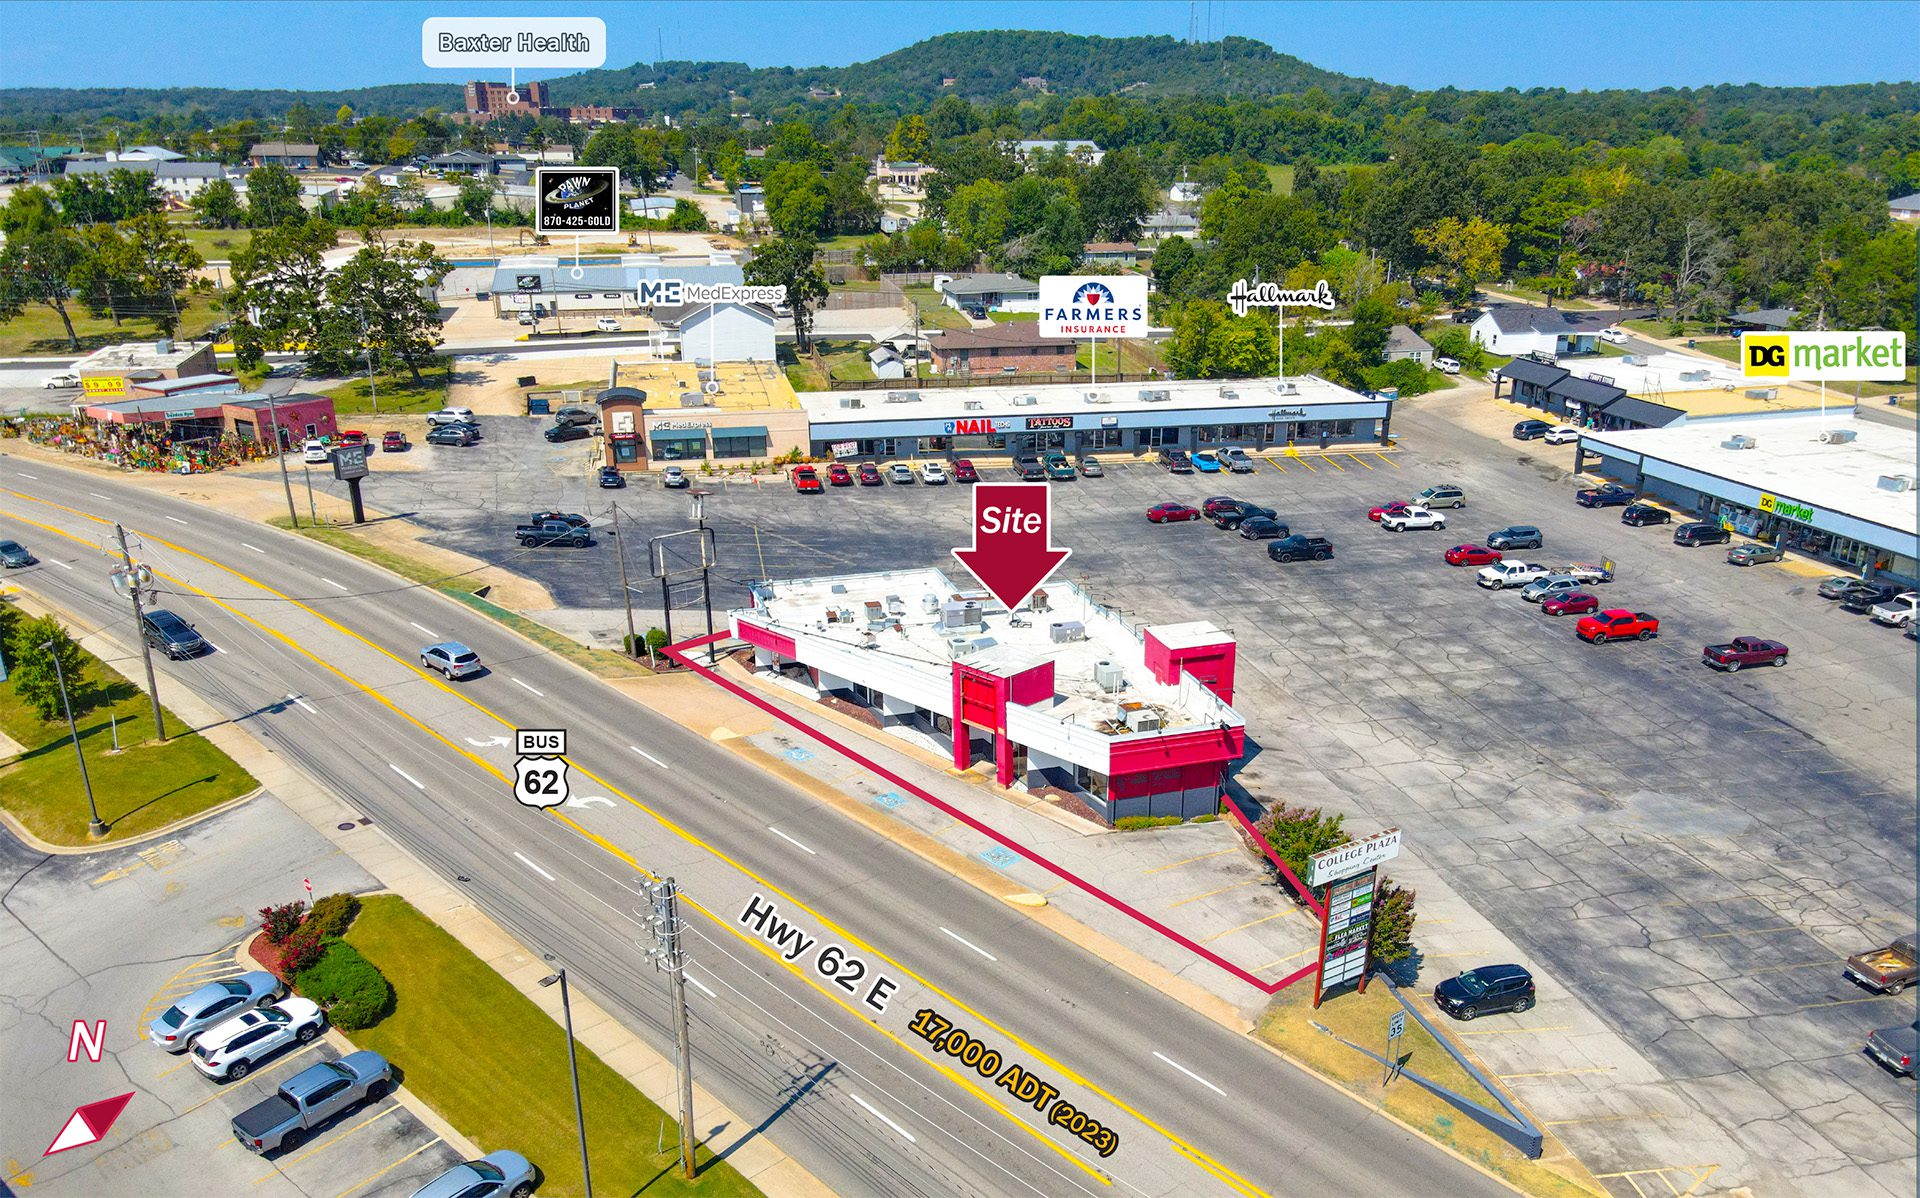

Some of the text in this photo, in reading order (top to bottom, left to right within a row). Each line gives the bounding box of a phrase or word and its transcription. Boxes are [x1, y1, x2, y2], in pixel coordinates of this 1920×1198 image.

[955, 418, 997, 434] NAIL
[1027, 416, 1071, 428] TATTOOS
[1761, 497, 1815, 523] DG market
[1317, 835, 1397, 870] COLLEGE PLAZA
[1390, 1023, 1403, 1037] 35
